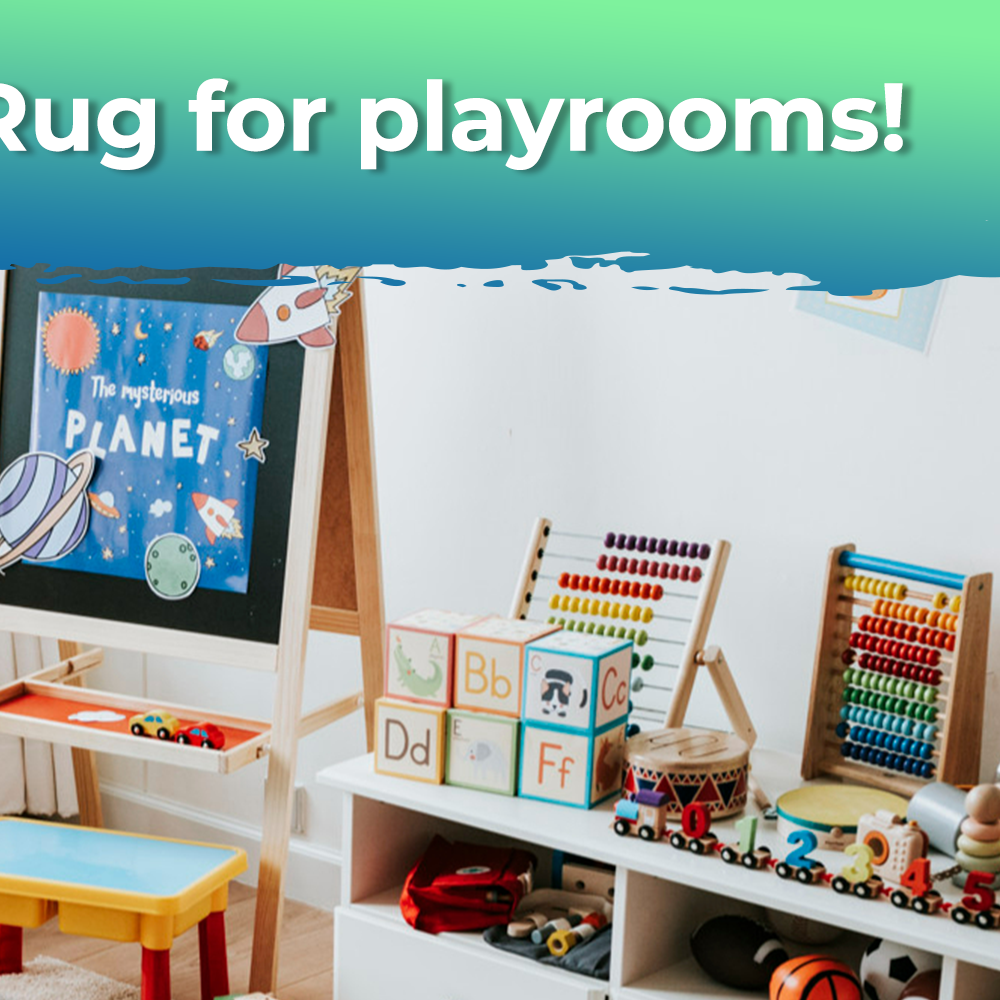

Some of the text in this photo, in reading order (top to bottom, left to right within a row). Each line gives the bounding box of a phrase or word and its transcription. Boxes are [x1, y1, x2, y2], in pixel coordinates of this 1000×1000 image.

[91, 375, 200, 409] The mysterious
[65, 409, 220, 465] PLANET
[429, 636, 441, 654] A
[530, 655, 542, 672] C
[465, 651, 512, 699] Bb
[601, 666, 627, 711] Cc
[385, 718, 430, 767] Dd
[453, 719, 462, 737] E
[538, 741, 575, 789] Ff
[735, 816, 758, 852] 1
[785, 830, 818, 870] 2
[842, 843, 876, 883] 3
[900, 857, 932, 897] 4
[962, 870, 997, 912] 5
